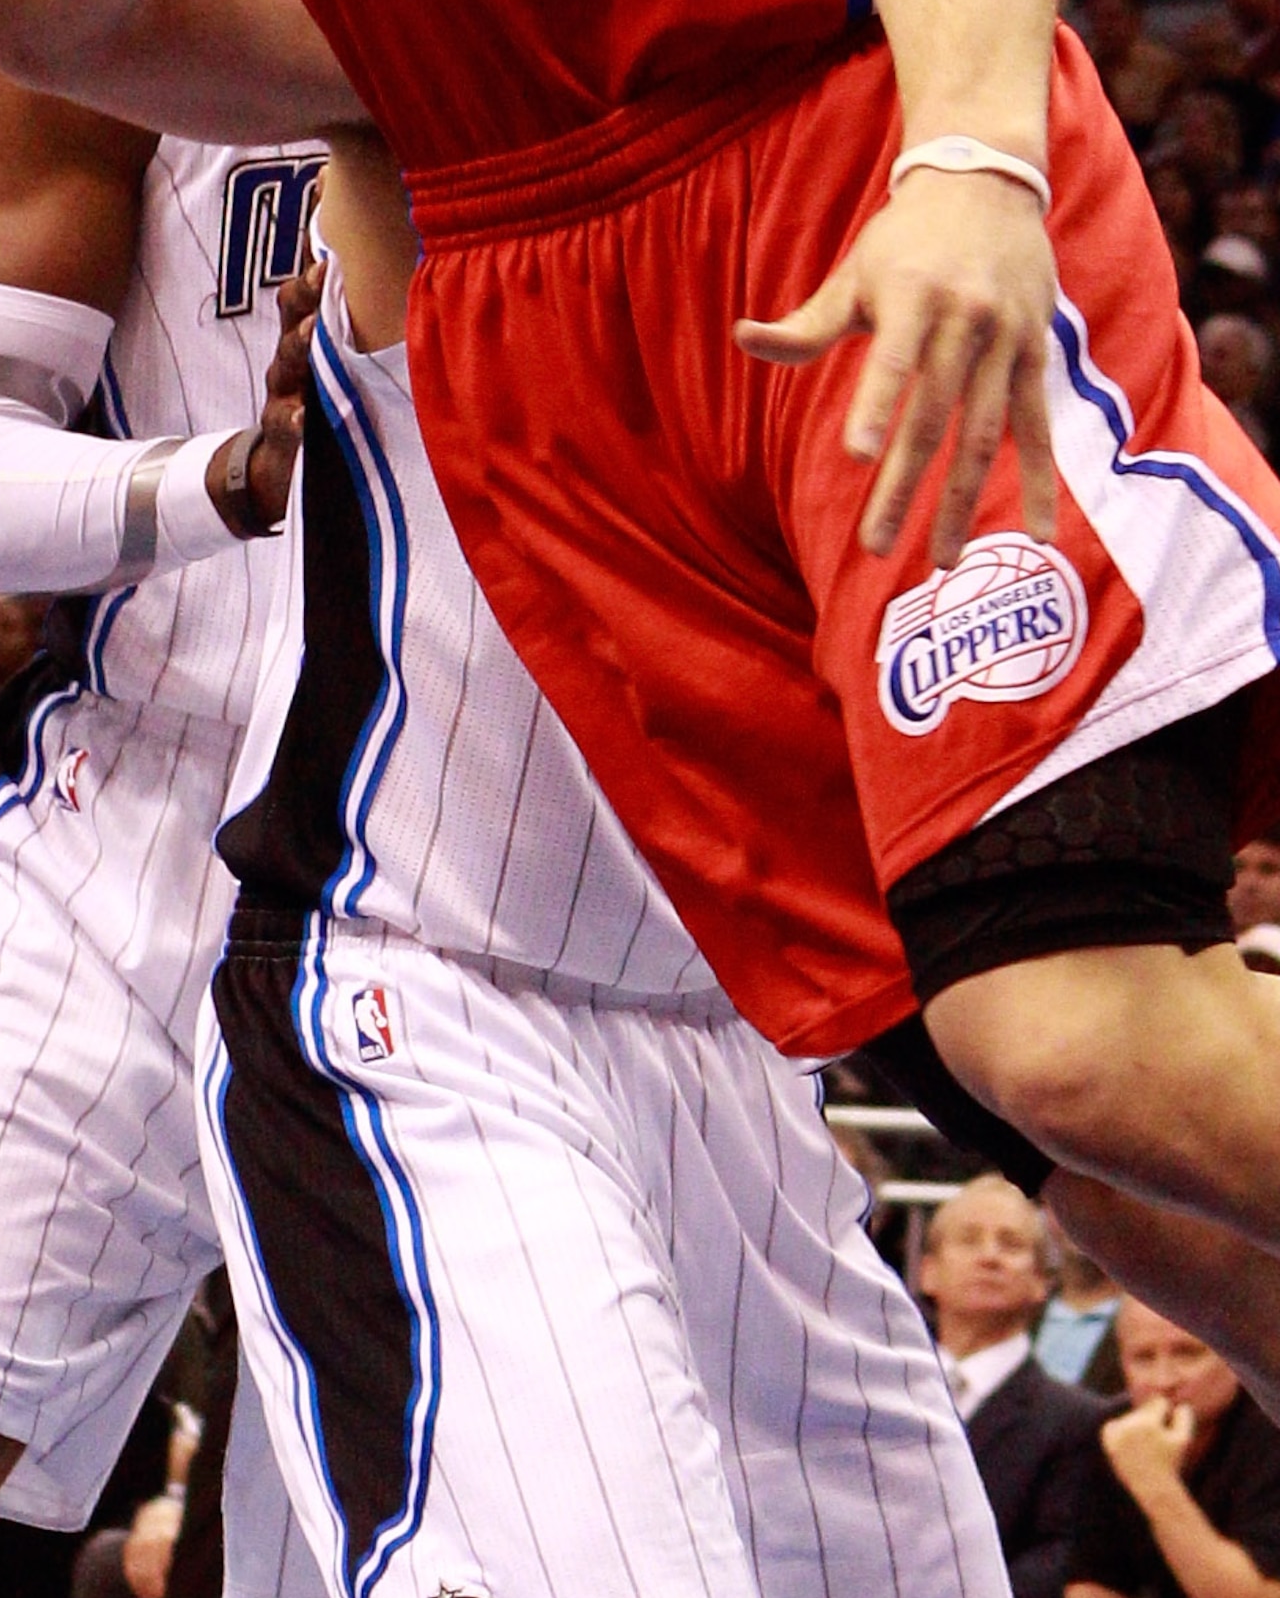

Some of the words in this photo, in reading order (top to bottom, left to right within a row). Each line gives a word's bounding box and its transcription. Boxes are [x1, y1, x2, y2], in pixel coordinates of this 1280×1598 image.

[939, 608, 971, 635] LOS
[977, 576, 1055, 617] ANGELES
[889, 597, 1064, 723] CLIPPERS
